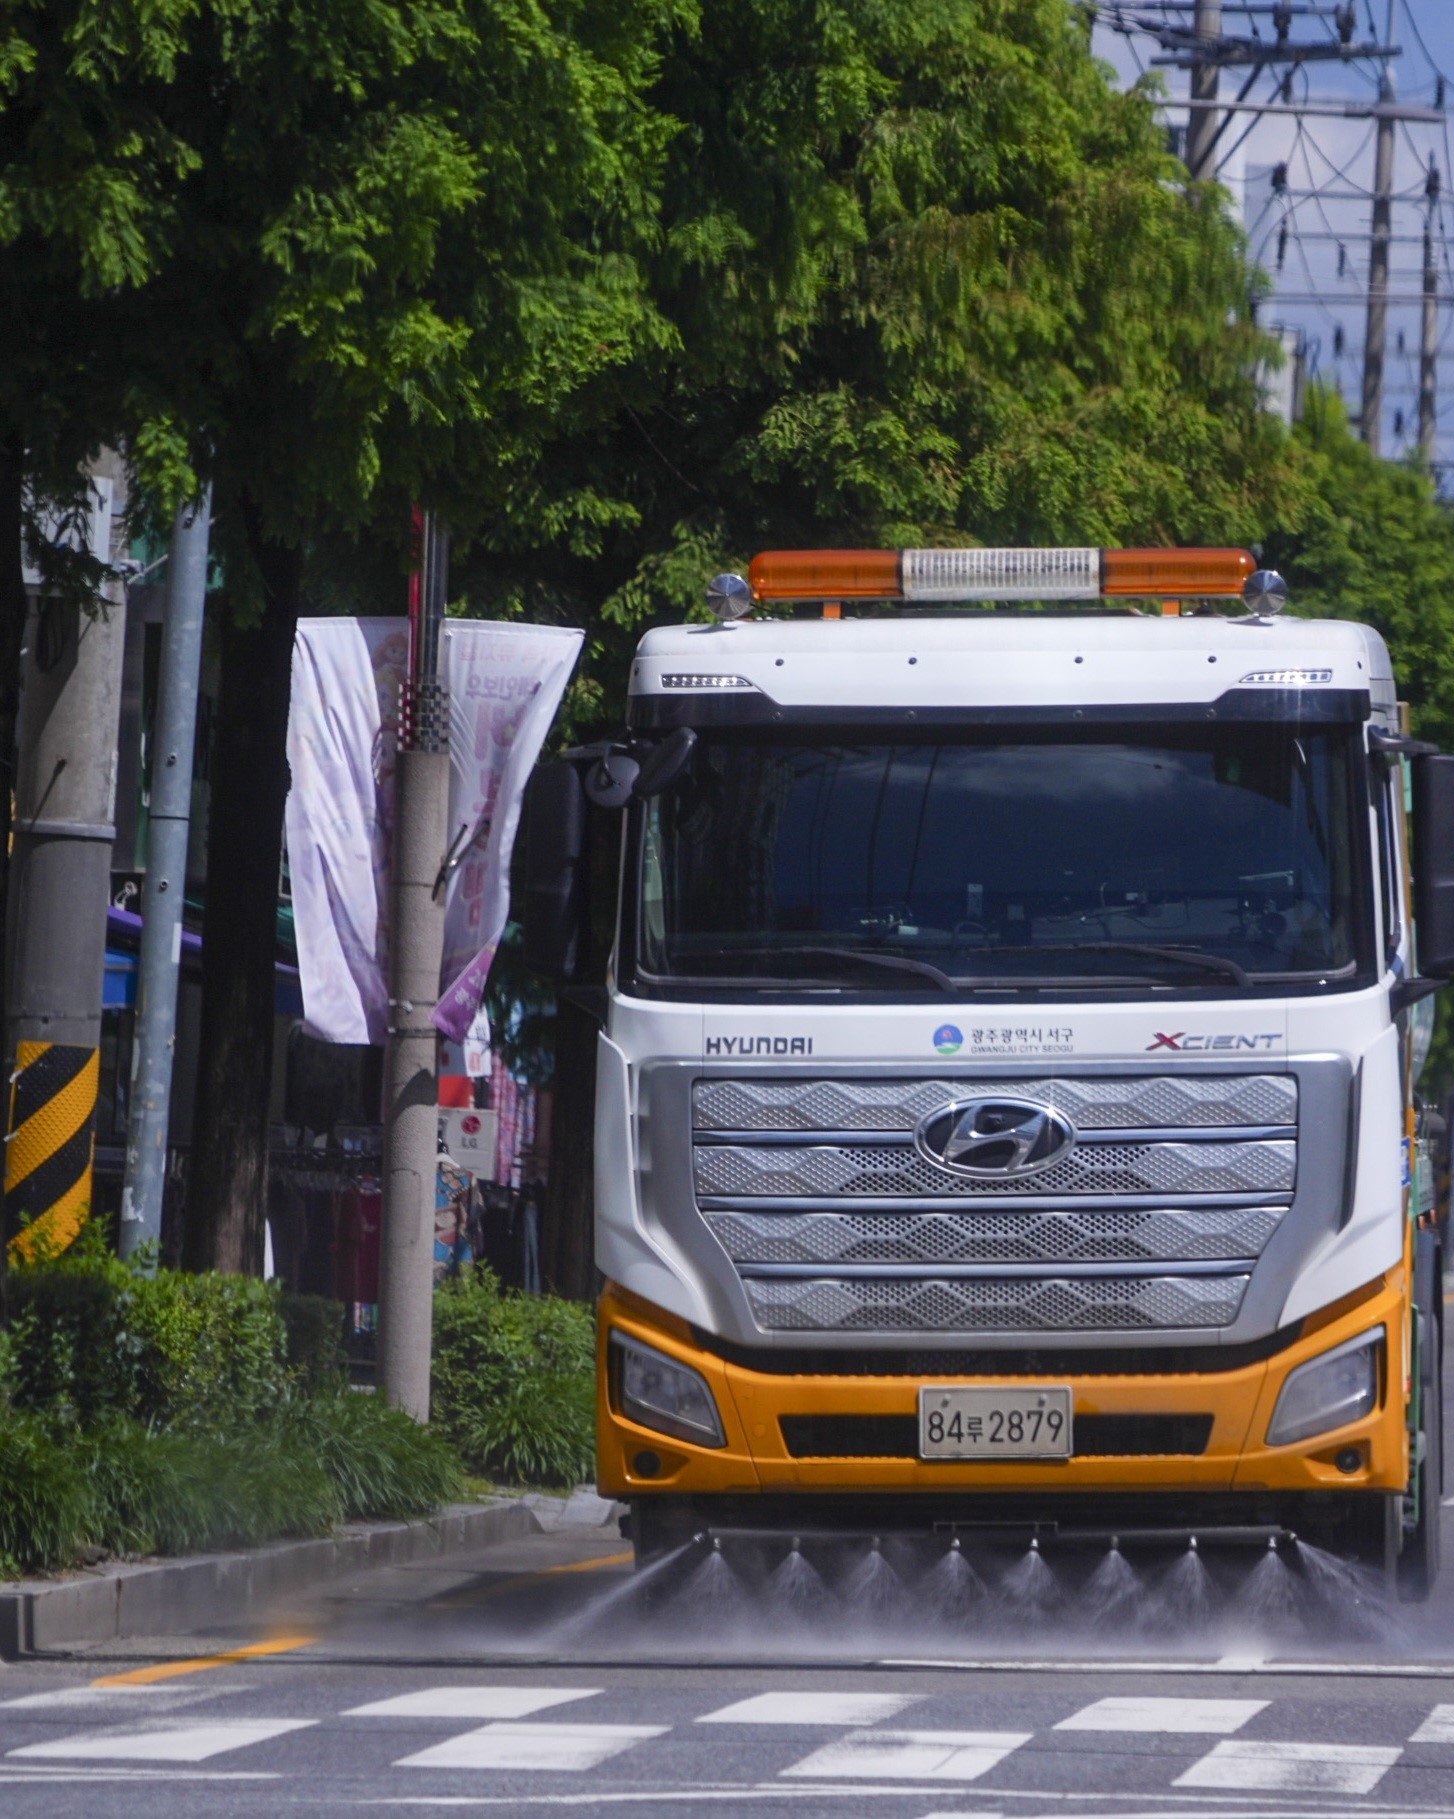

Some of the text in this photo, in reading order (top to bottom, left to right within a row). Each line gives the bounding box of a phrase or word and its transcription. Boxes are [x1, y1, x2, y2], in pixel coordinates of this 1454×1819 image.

[971, 1027, 1074, 1044] 광주광역시 서구
[1145, 1032, 1283, 1051] XCIENT
[706, 1037, 813, 1055] HYUNDAI
[971, 1044, 1074, 1054] GWANGJU CITY SEOGU
[460, 1137, 478, 1149] LG
